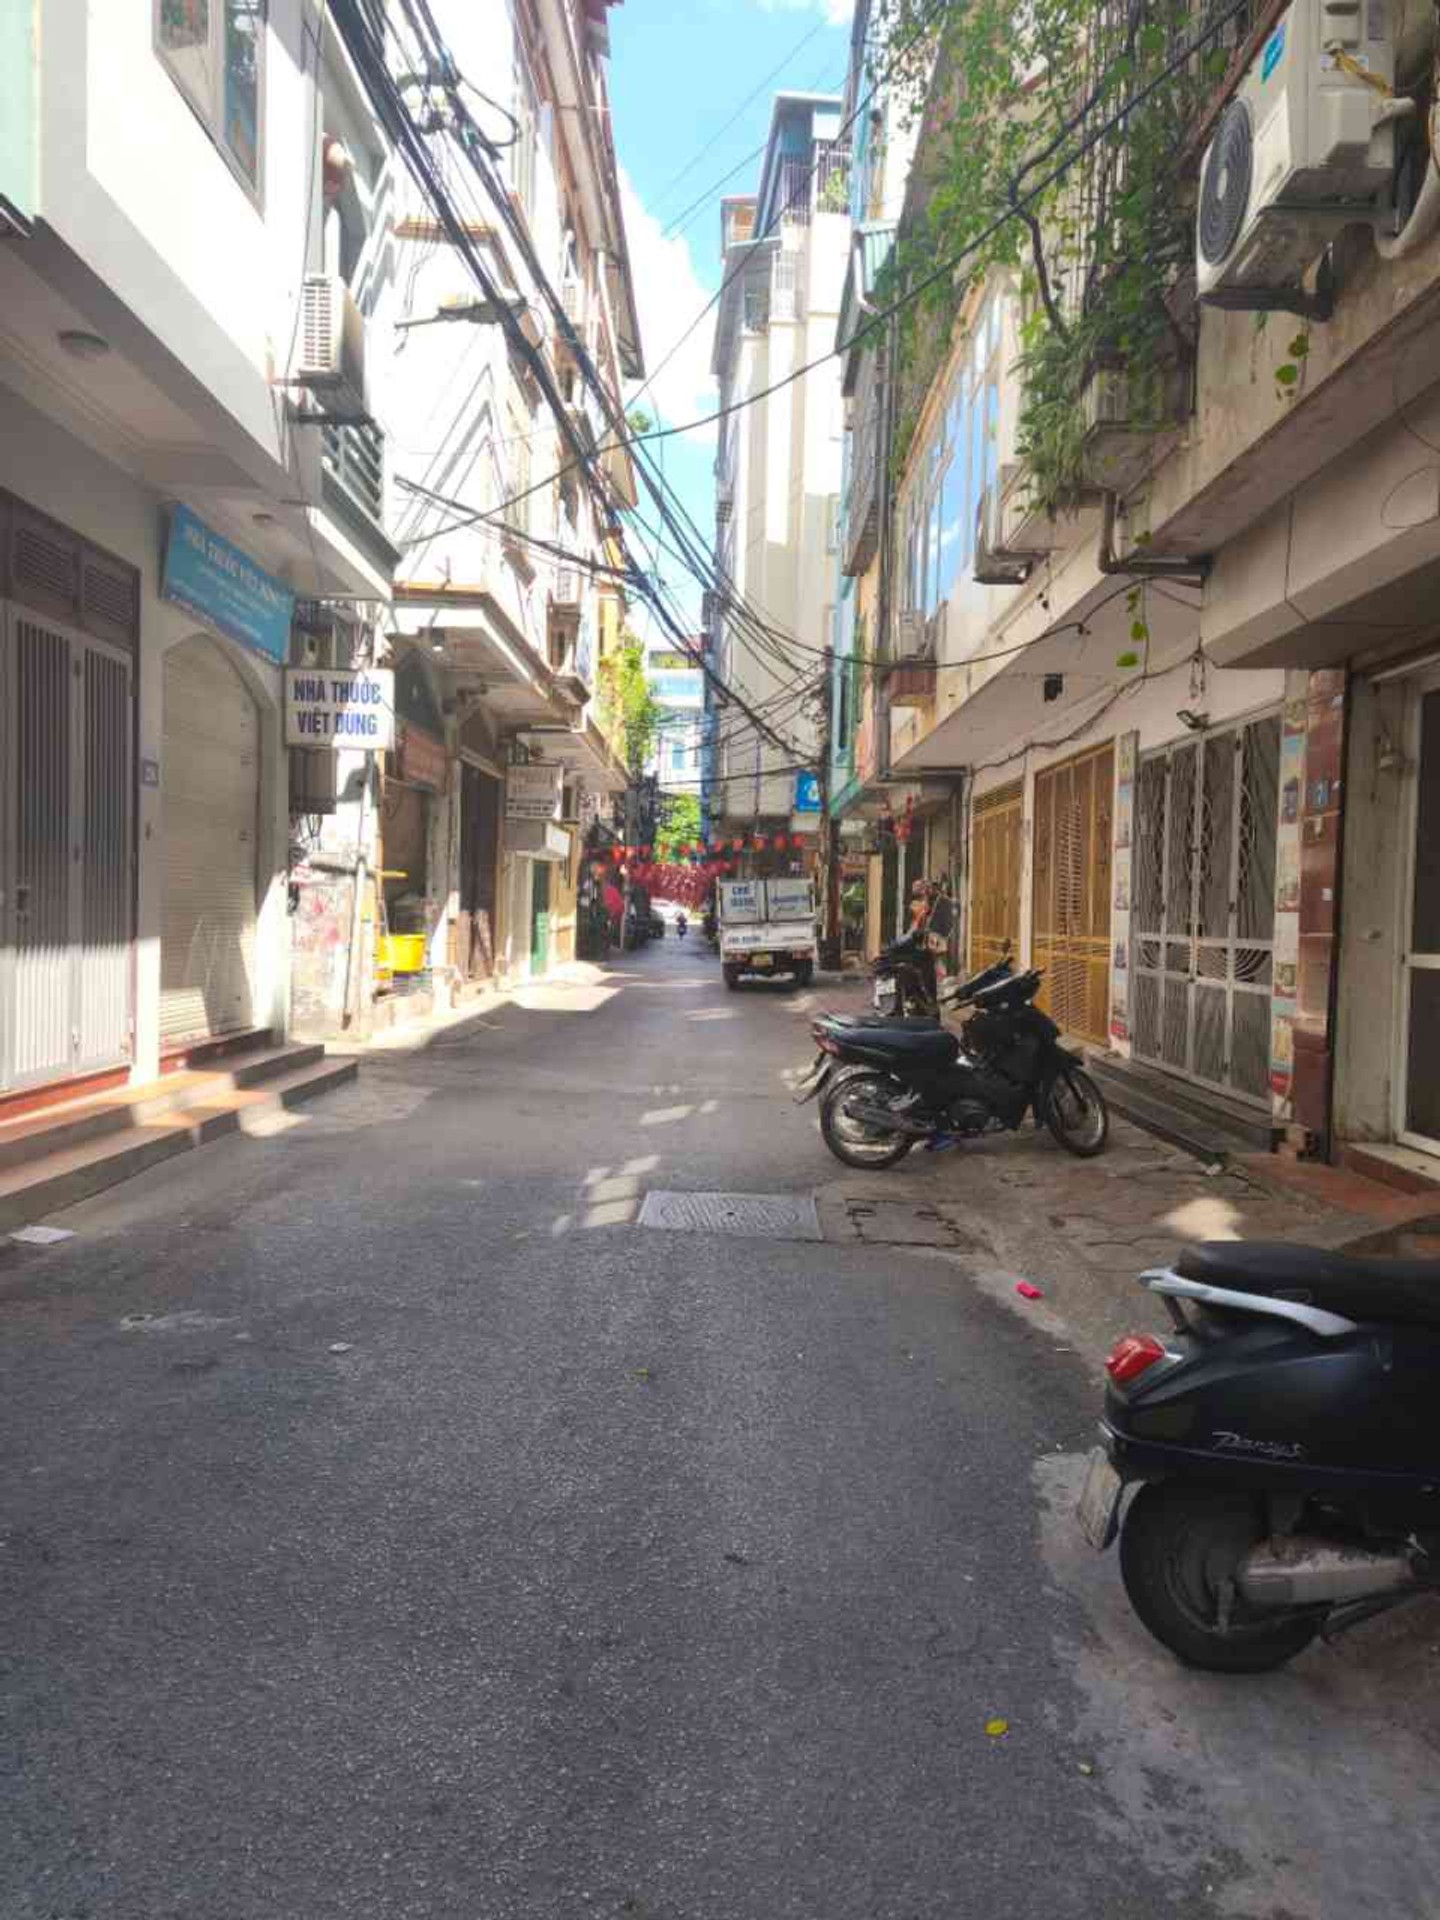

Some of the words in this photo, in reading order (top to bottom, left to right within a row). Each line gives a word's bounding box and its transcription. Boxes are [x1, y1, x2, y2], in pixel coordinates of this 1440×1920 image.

[294, 675, 326, 702] NHÀ
[330, 676, 382, 705] THUỐC
[297, 706, 330, 737] VIỆT
